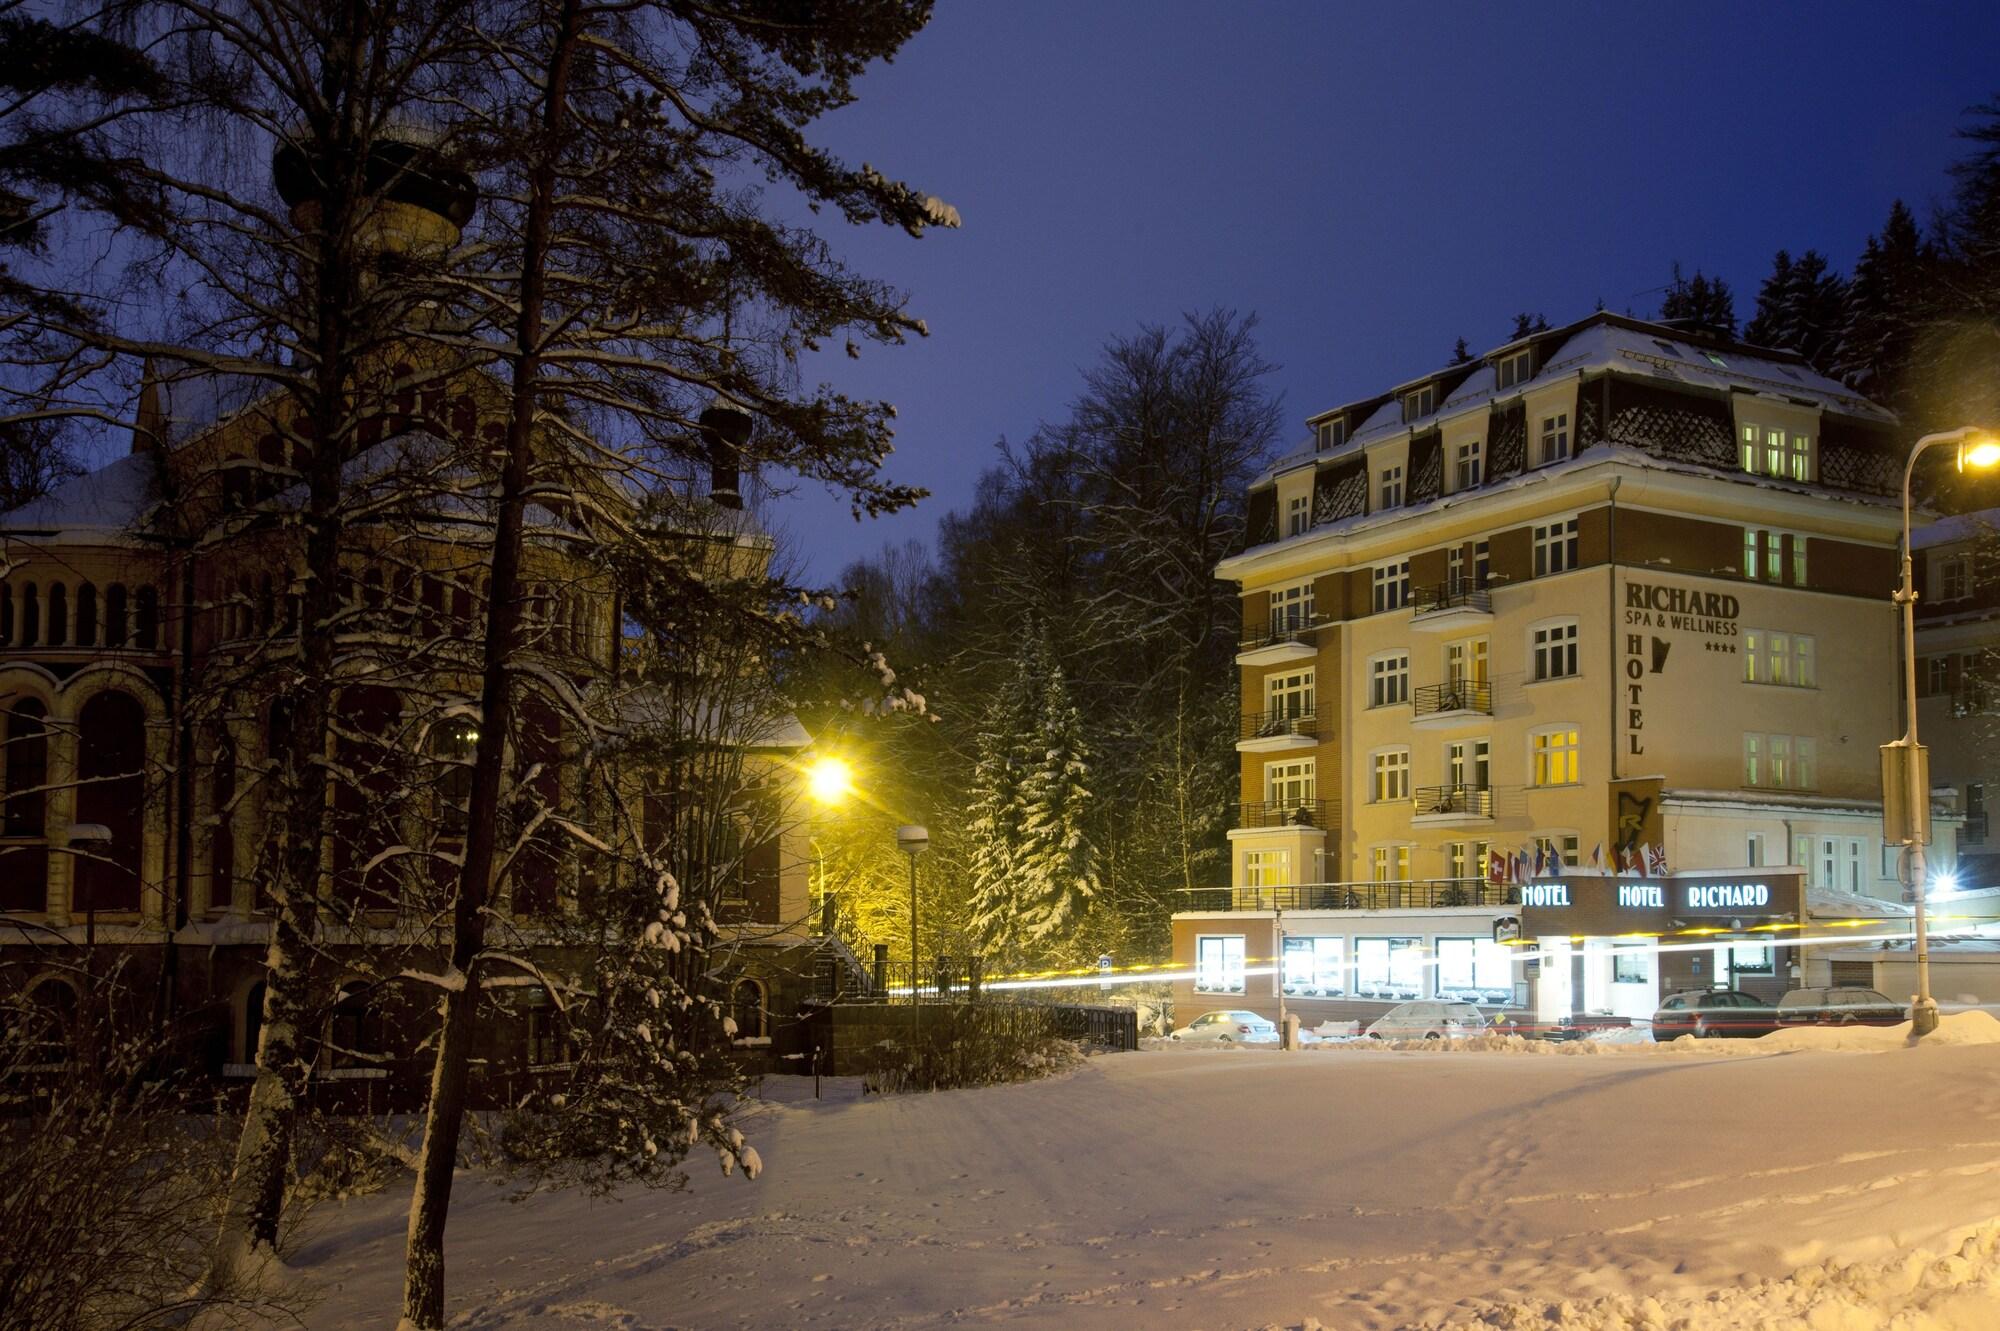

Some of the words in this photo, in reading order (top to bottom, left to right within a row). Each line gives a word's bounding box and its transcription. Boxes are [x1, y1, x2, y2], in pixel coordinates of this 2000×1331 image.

[1625, 583, 1739, 619] RICHARD
[1625, 610, 1652, 626] SPA
[1656, 616, 1666, 628] &
[1670, 615, 1738, 636] WELLNESS
[1627, 634, 1644, 755] HOTEL
[1521, 885, 1570, 906] HOTEL
[1619, 886, 1664, 907] HOTEL
[1688, 884, 1768, 907] RICHARD
[1101, 960, 1110, 969] P
